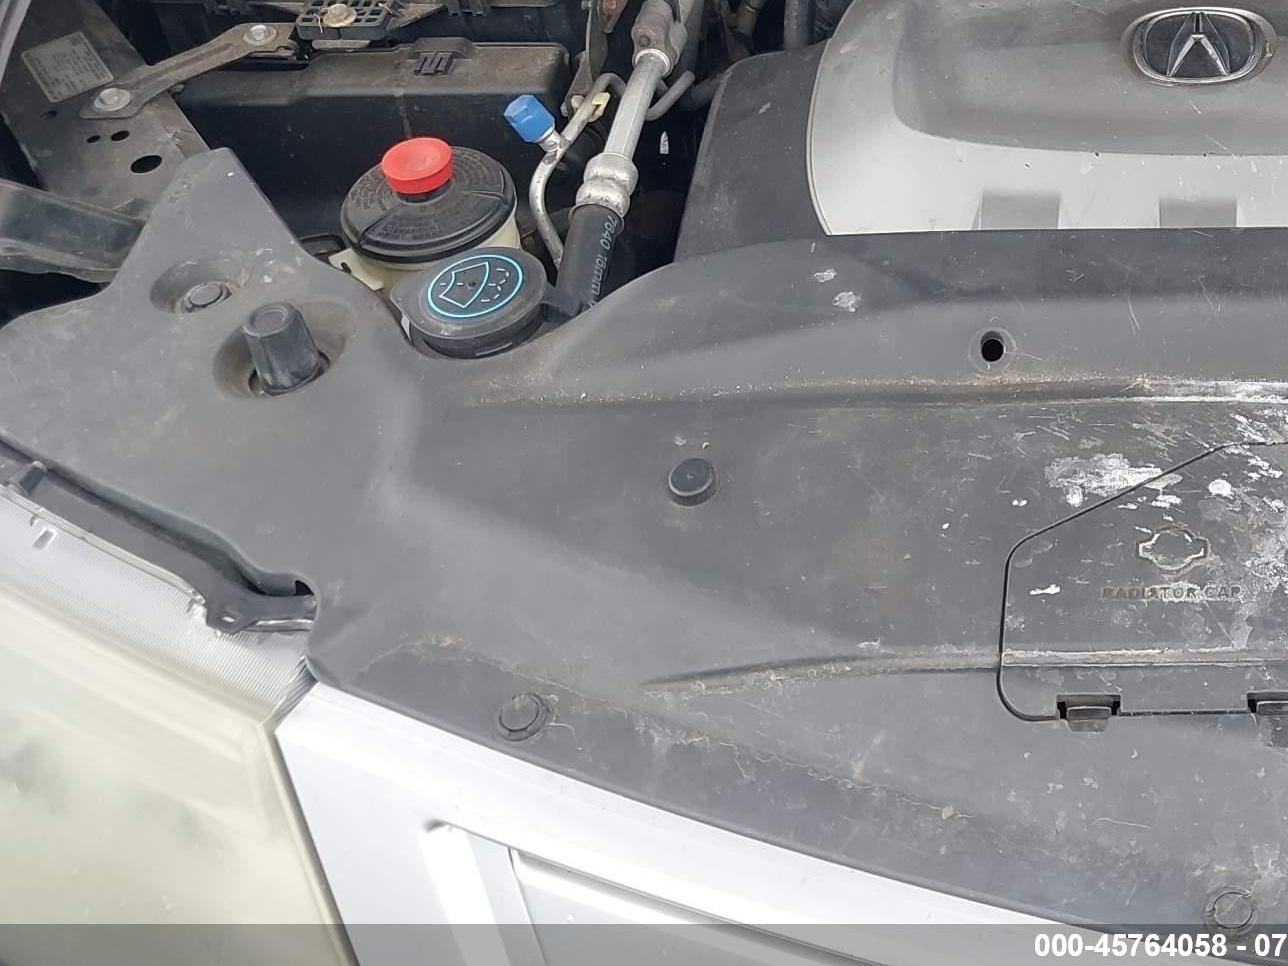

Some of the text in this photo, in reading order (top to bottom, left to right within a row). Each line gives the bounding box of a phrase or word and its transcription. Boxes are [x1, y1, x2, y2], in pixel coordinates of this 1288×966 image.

[600, 214, 619, 251] 7640
[1102, 585, 1243, 600] RADIATOR CAP
